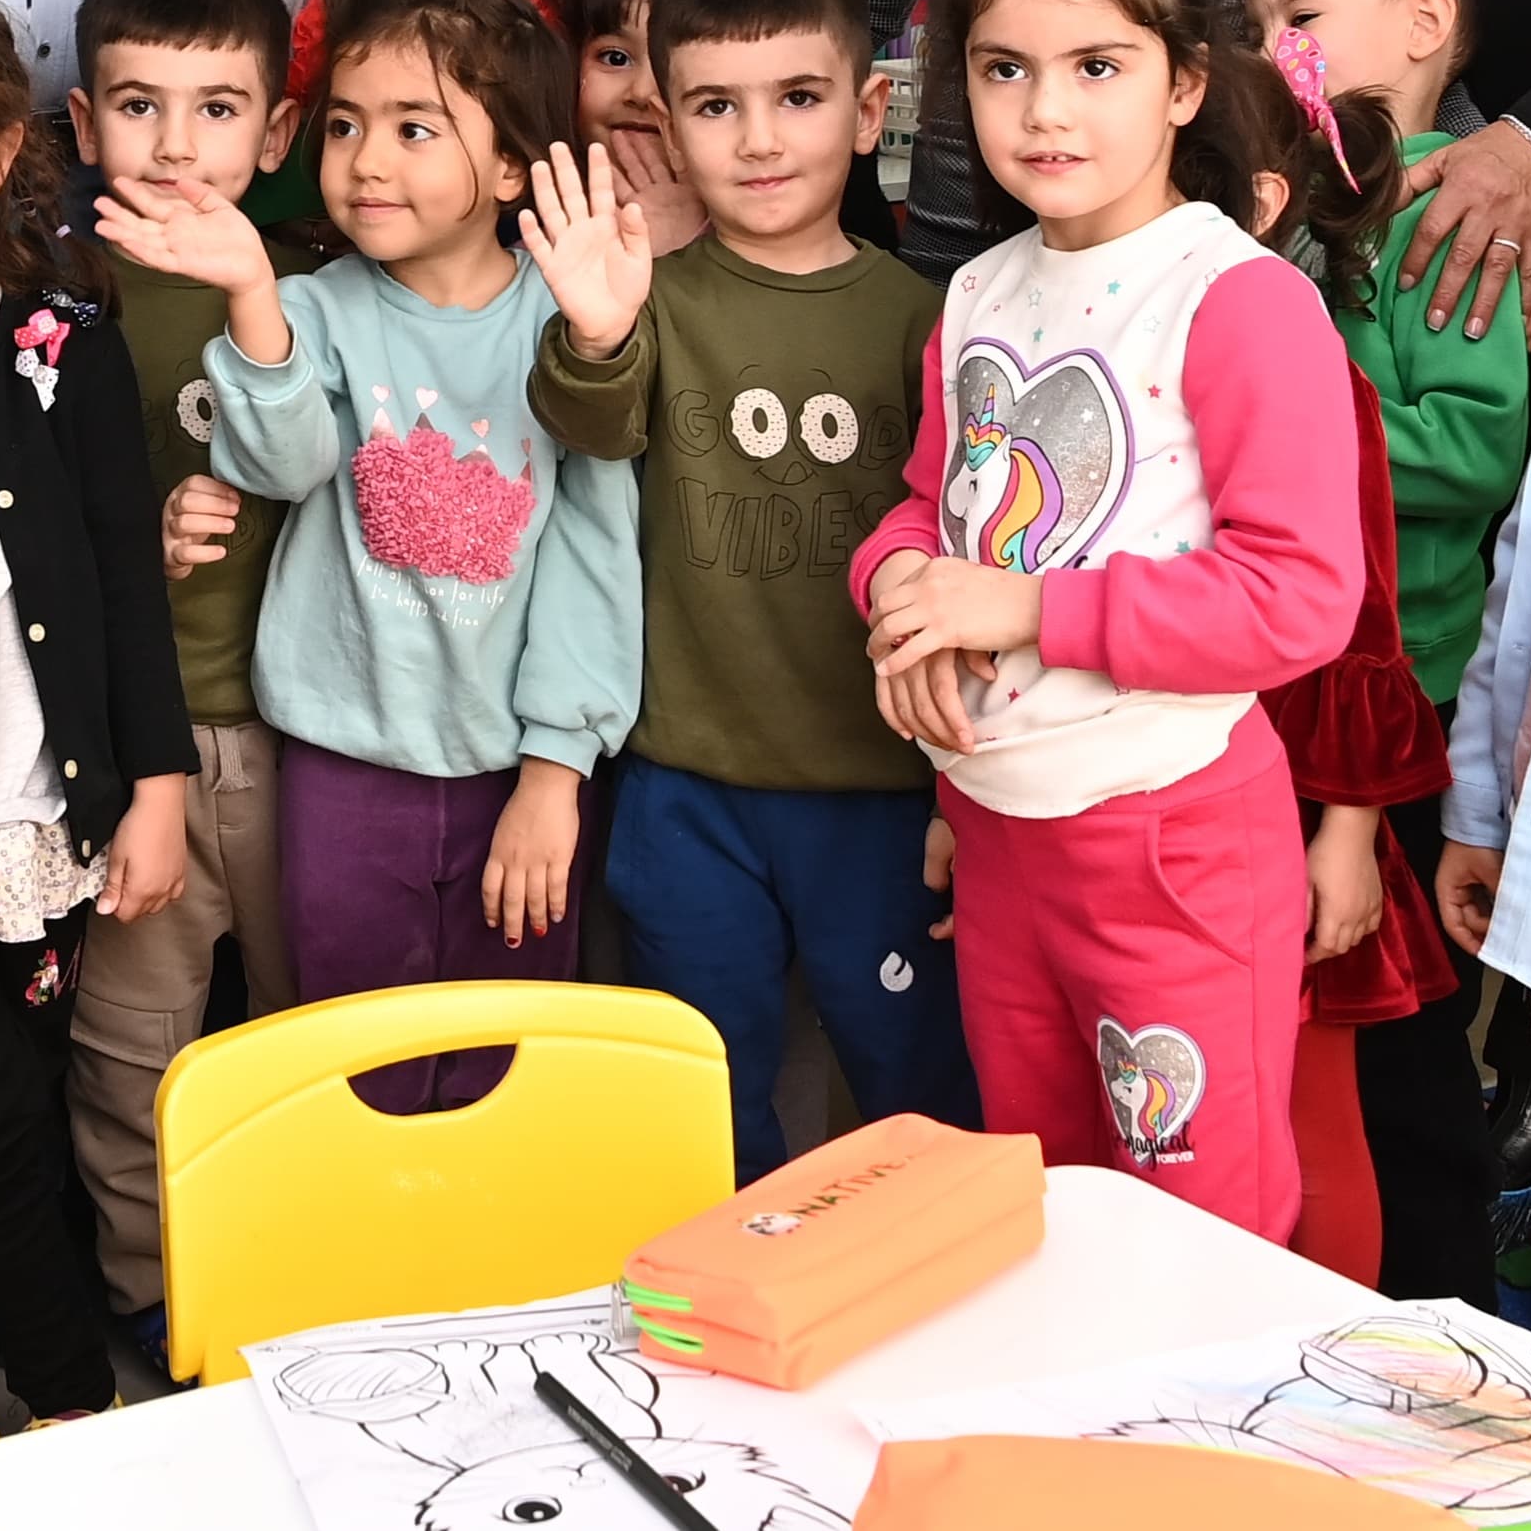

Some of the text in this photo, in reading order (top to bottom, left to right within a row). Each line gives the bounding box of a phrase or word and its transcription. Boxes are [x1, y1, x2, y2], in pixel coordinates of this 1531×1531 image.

[667, 387, 908, 470] GOOD
[451, 580, 473, 606] for
[480, 585, 505, 610] life
